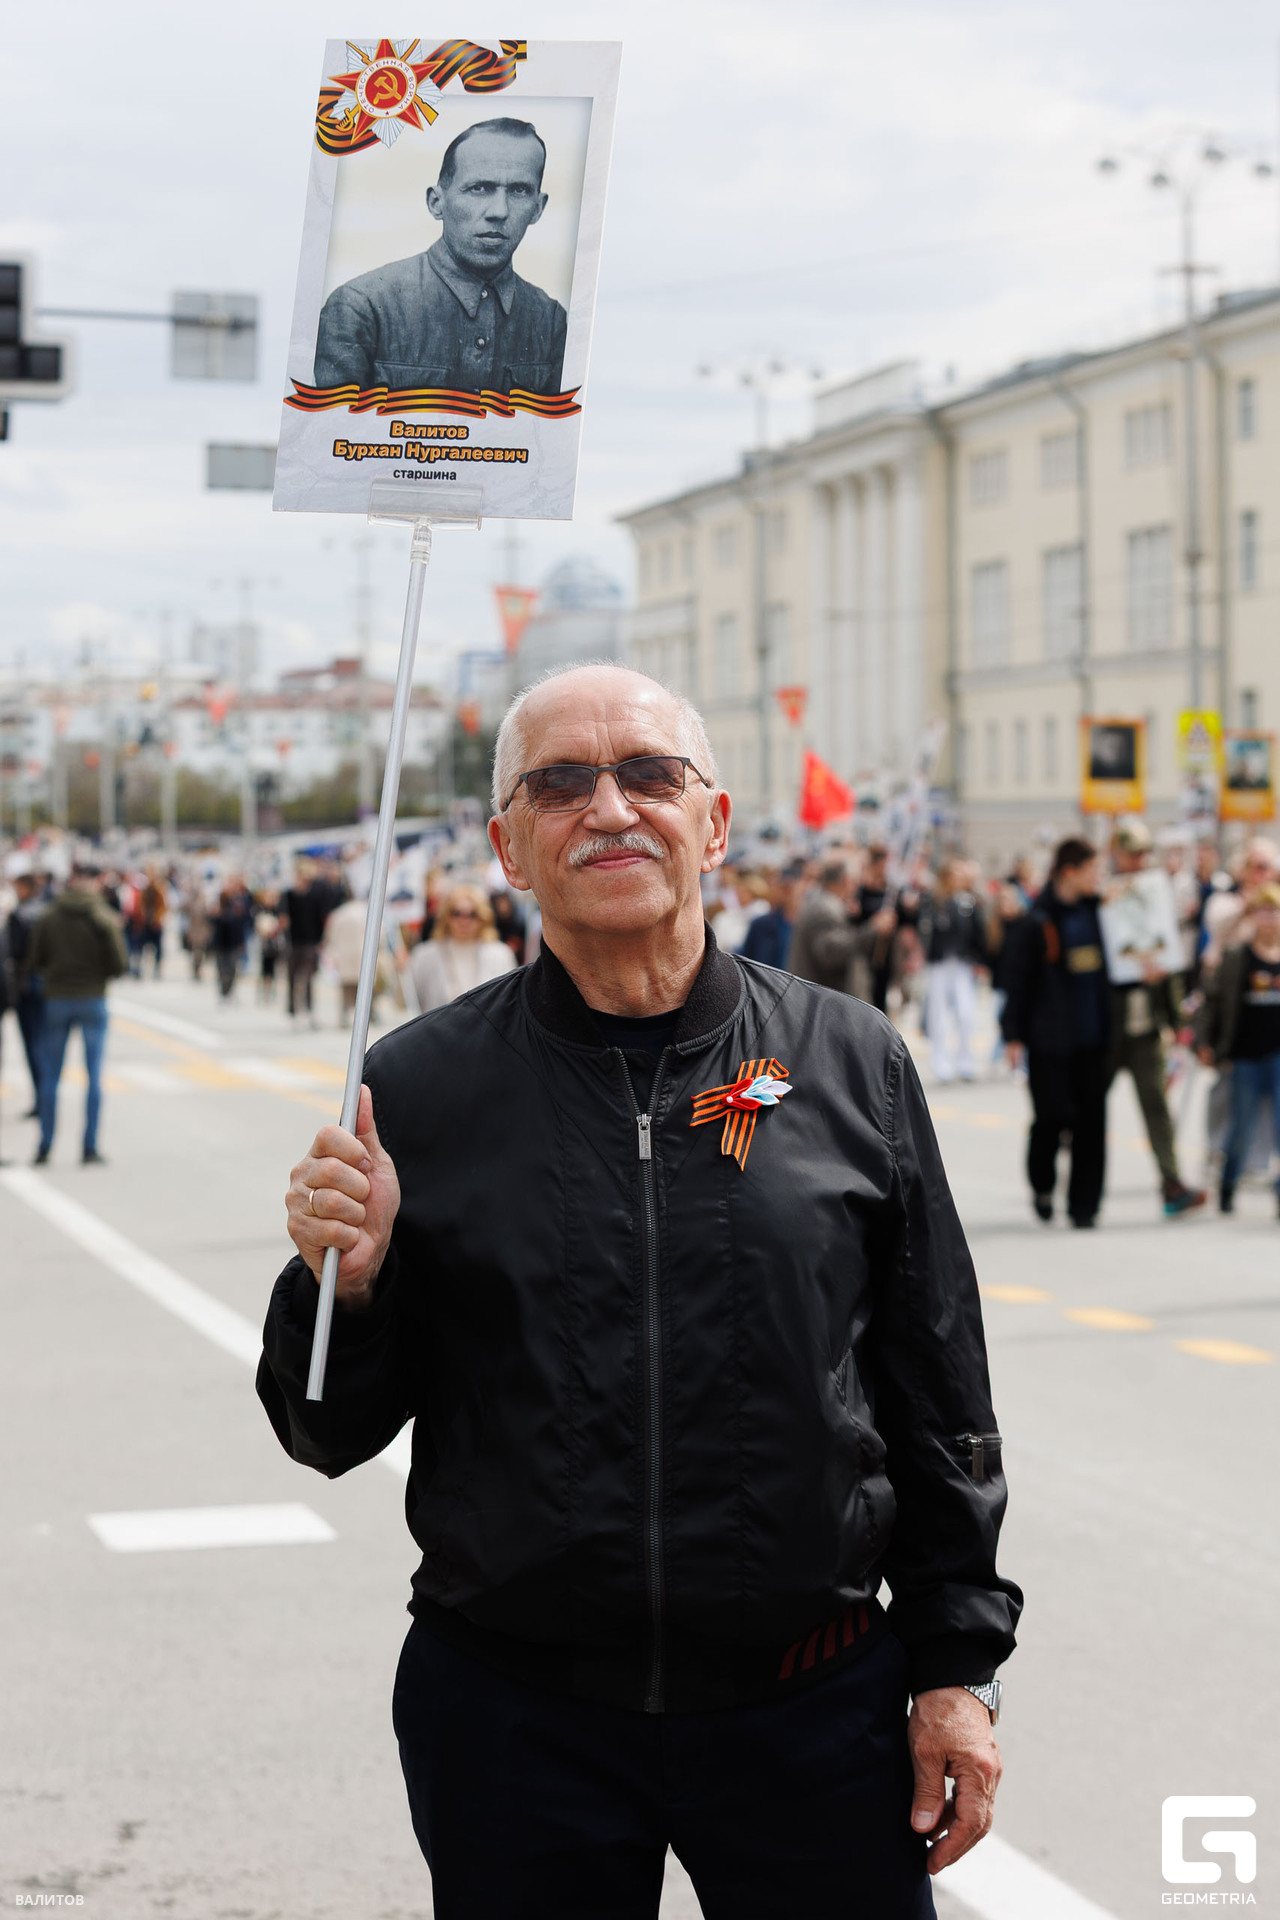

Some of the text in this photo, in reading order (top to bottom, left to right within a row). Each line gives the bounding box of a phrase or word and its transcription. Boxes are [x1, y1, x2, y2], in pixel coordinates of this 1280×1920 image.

[359, 60, 409, 113] ОТЕЧЕСТВЕННАЯ
[390, 421, 469, 440] Валитов
[333, 439, 529, 463] Бурхан Нургалеевич
[393, 468, 457, 481] старшина
